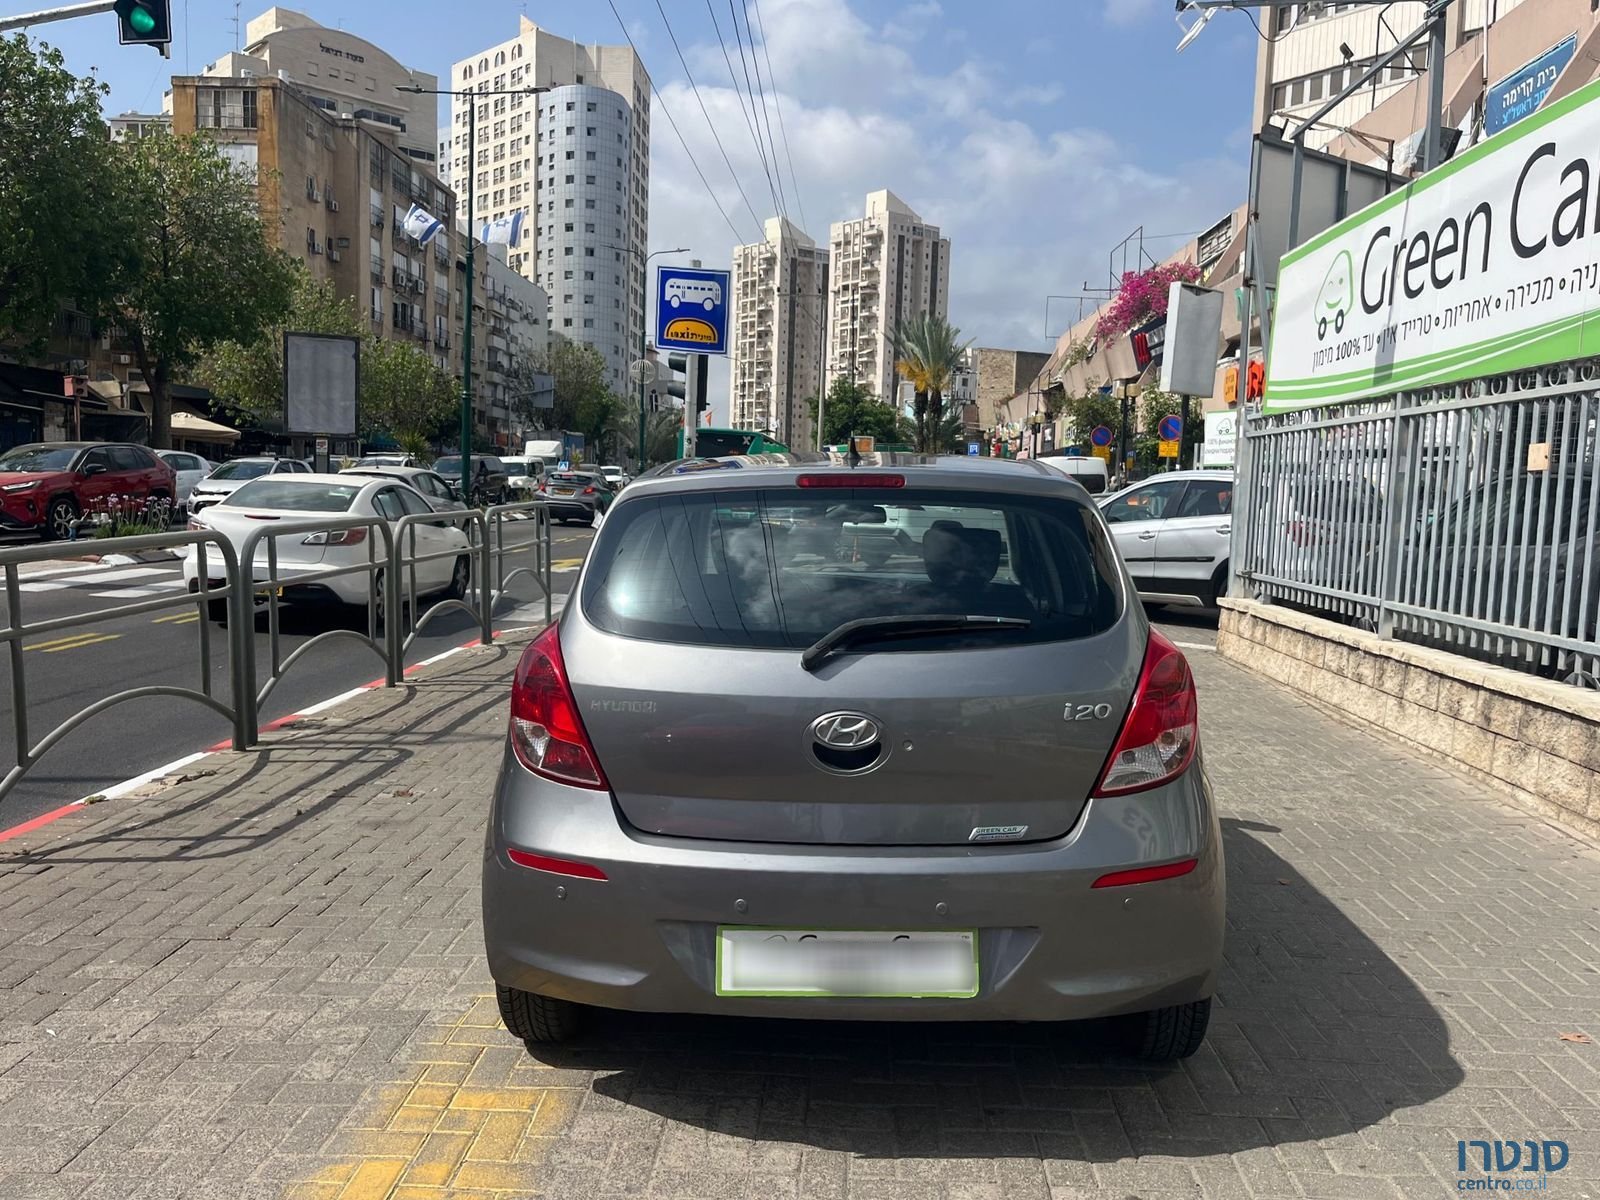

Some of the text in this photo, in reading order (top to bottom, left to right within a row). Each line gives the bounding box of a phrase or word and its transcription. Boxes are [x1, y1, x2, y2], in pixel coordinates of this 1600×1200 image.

[319, 42, 343, 57] דניאל
[1537, 65, 1557, 88] בית
[1361, 201, 1492, 315] Green
[1313, 262, 1600, 373] ניה מכירה אחריות טרייד אין עד 100% מימון
[690, 331, 712, 341] מונית
[590, 700, 657, 713] HYUNDAI
[1063, 702, 1112, 721] i20
